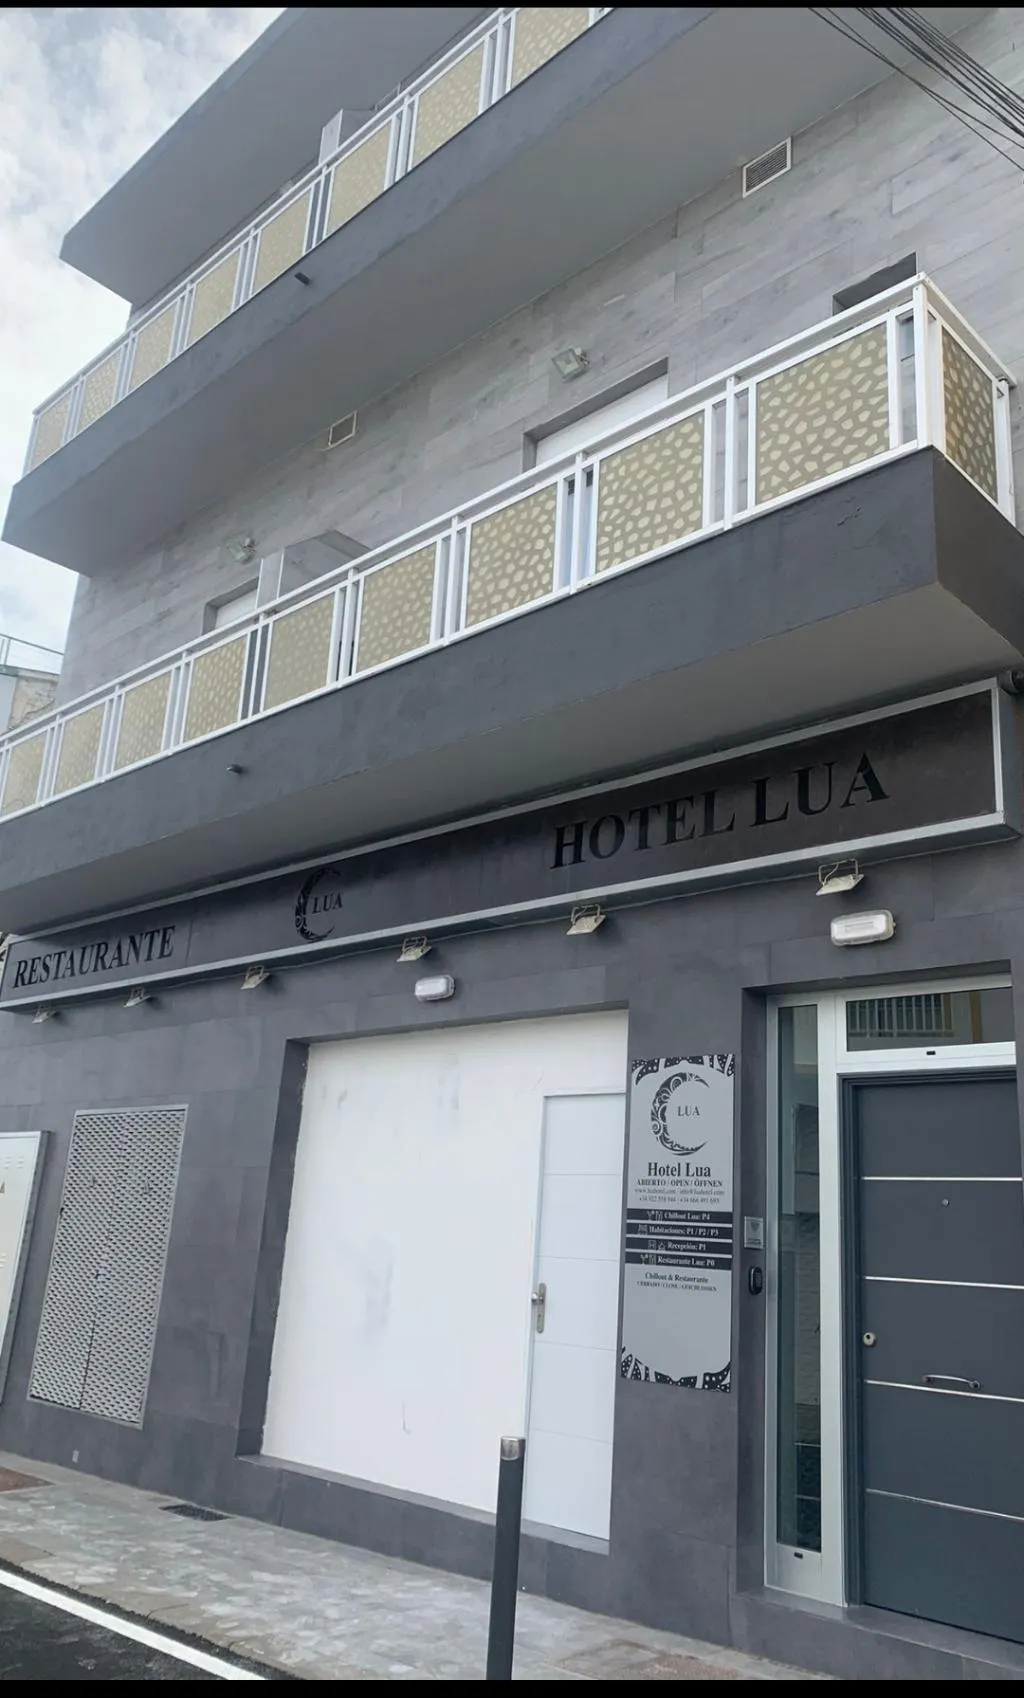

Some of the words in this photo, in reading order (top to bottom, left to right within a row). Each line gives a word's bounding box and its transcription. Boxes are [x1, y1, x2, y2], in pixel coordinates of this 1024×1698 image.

[550, 789, 736, 869] HOTEL
[750, 752, 890, 828] LUA
[311, 892, 344, 915] LUA
[12, 925, 175, 989] RESTAURANTE
[677, 1106, 700, 1117] LUA
[648, 1162, 680, 1177] Hotel
[685, 1162, 711, 1177] Lua
[637, 1179, 666, 1187] ABIERTO
[670, 1179, 689, 1187] OPEN
